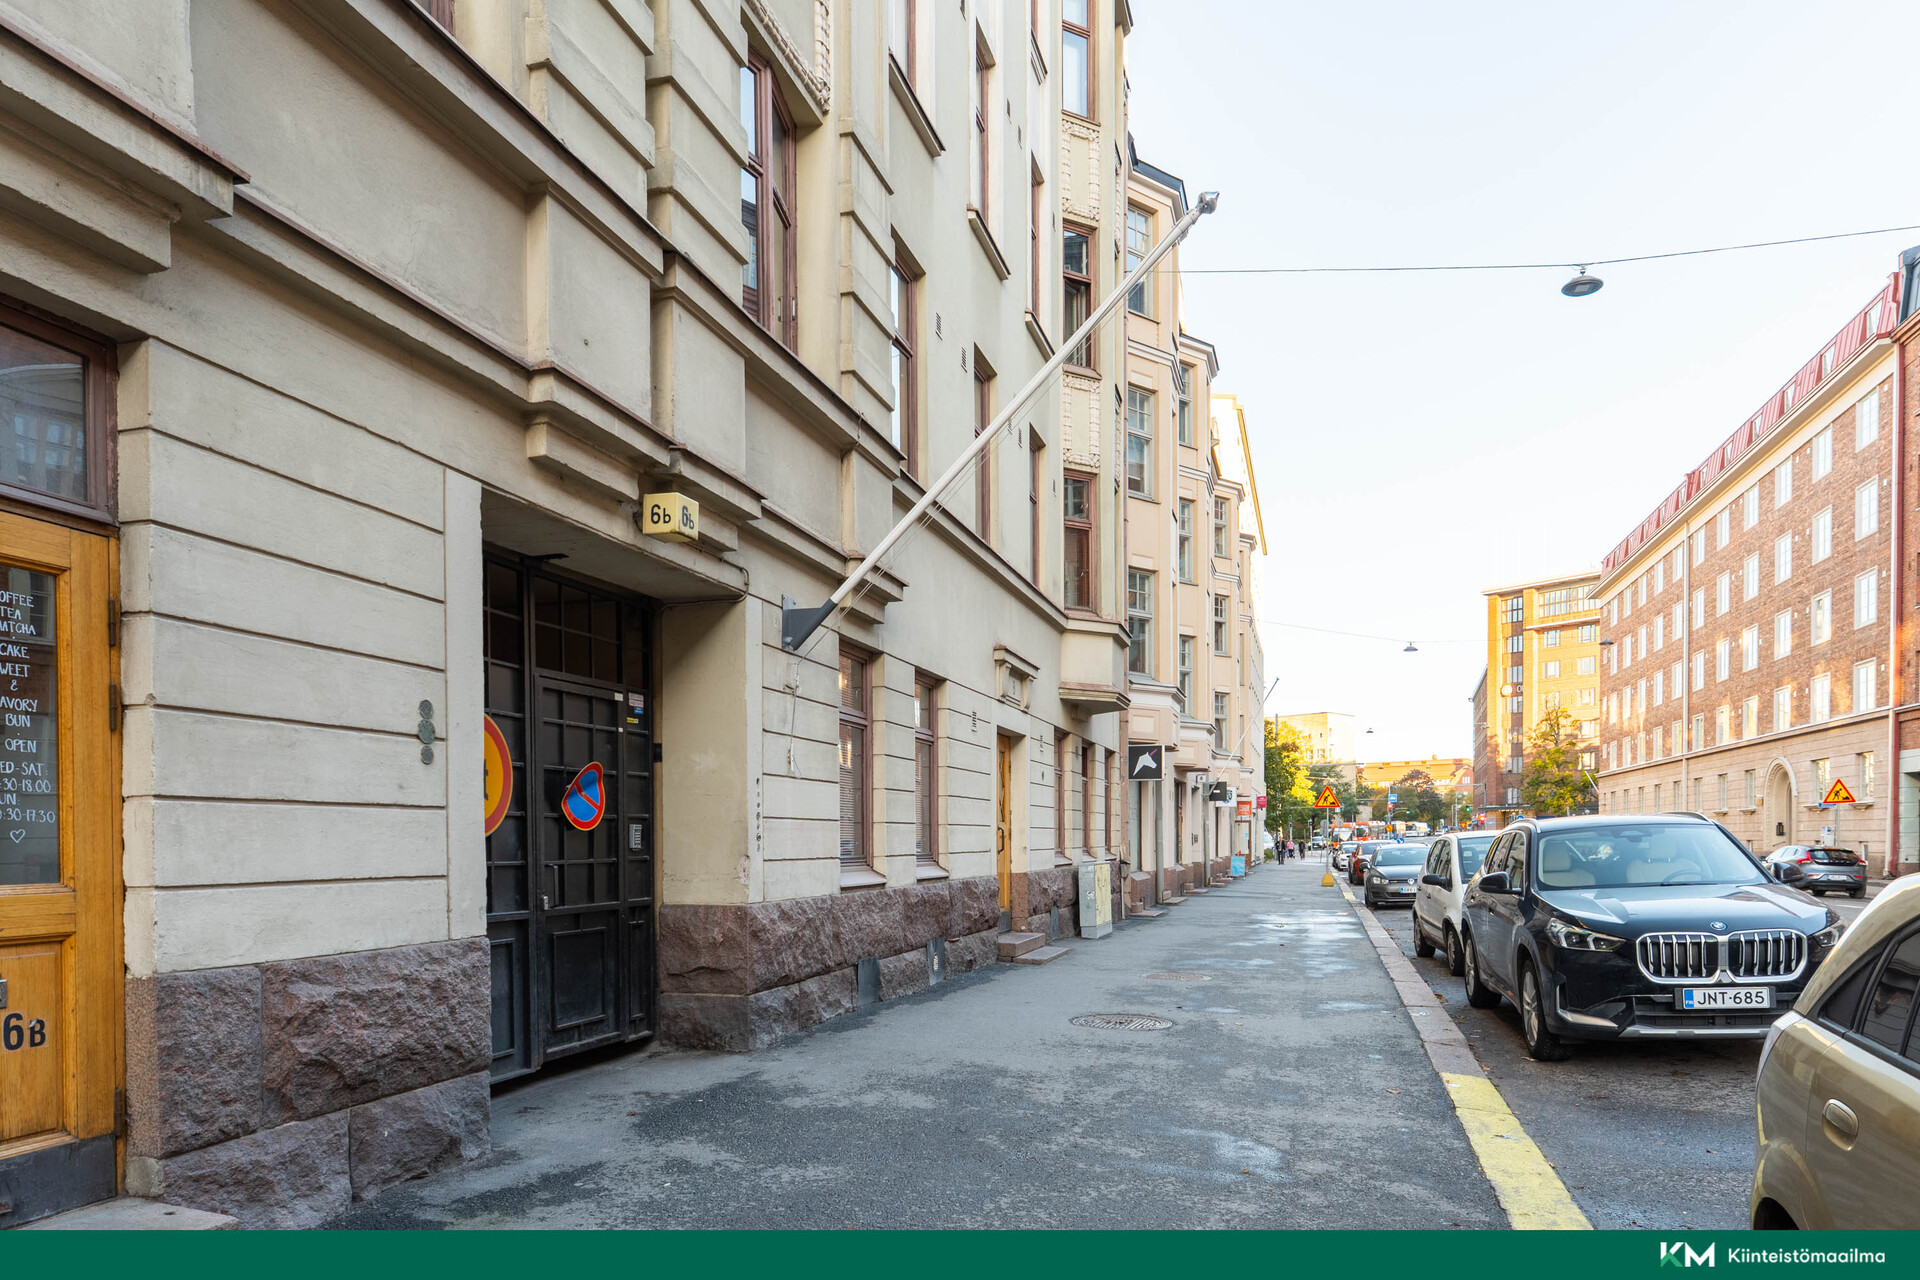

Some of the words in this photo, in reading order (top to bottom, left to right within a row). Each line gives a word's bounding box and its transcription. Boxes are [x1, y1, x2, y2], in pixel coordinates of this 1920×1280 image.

[651, 504, 671, 524] 6b
[682, 505, 695, 530] 6b
[0, 605, 21, 620] TEA
[0, 643, 30, 659] CAKE
[5, 713, 31, 728] BUN
[4, 738, 37, 753] OPEN
[1697, 991, 1765, 1005] JNT-685
[3, 1012, 46, 1051] 6B
